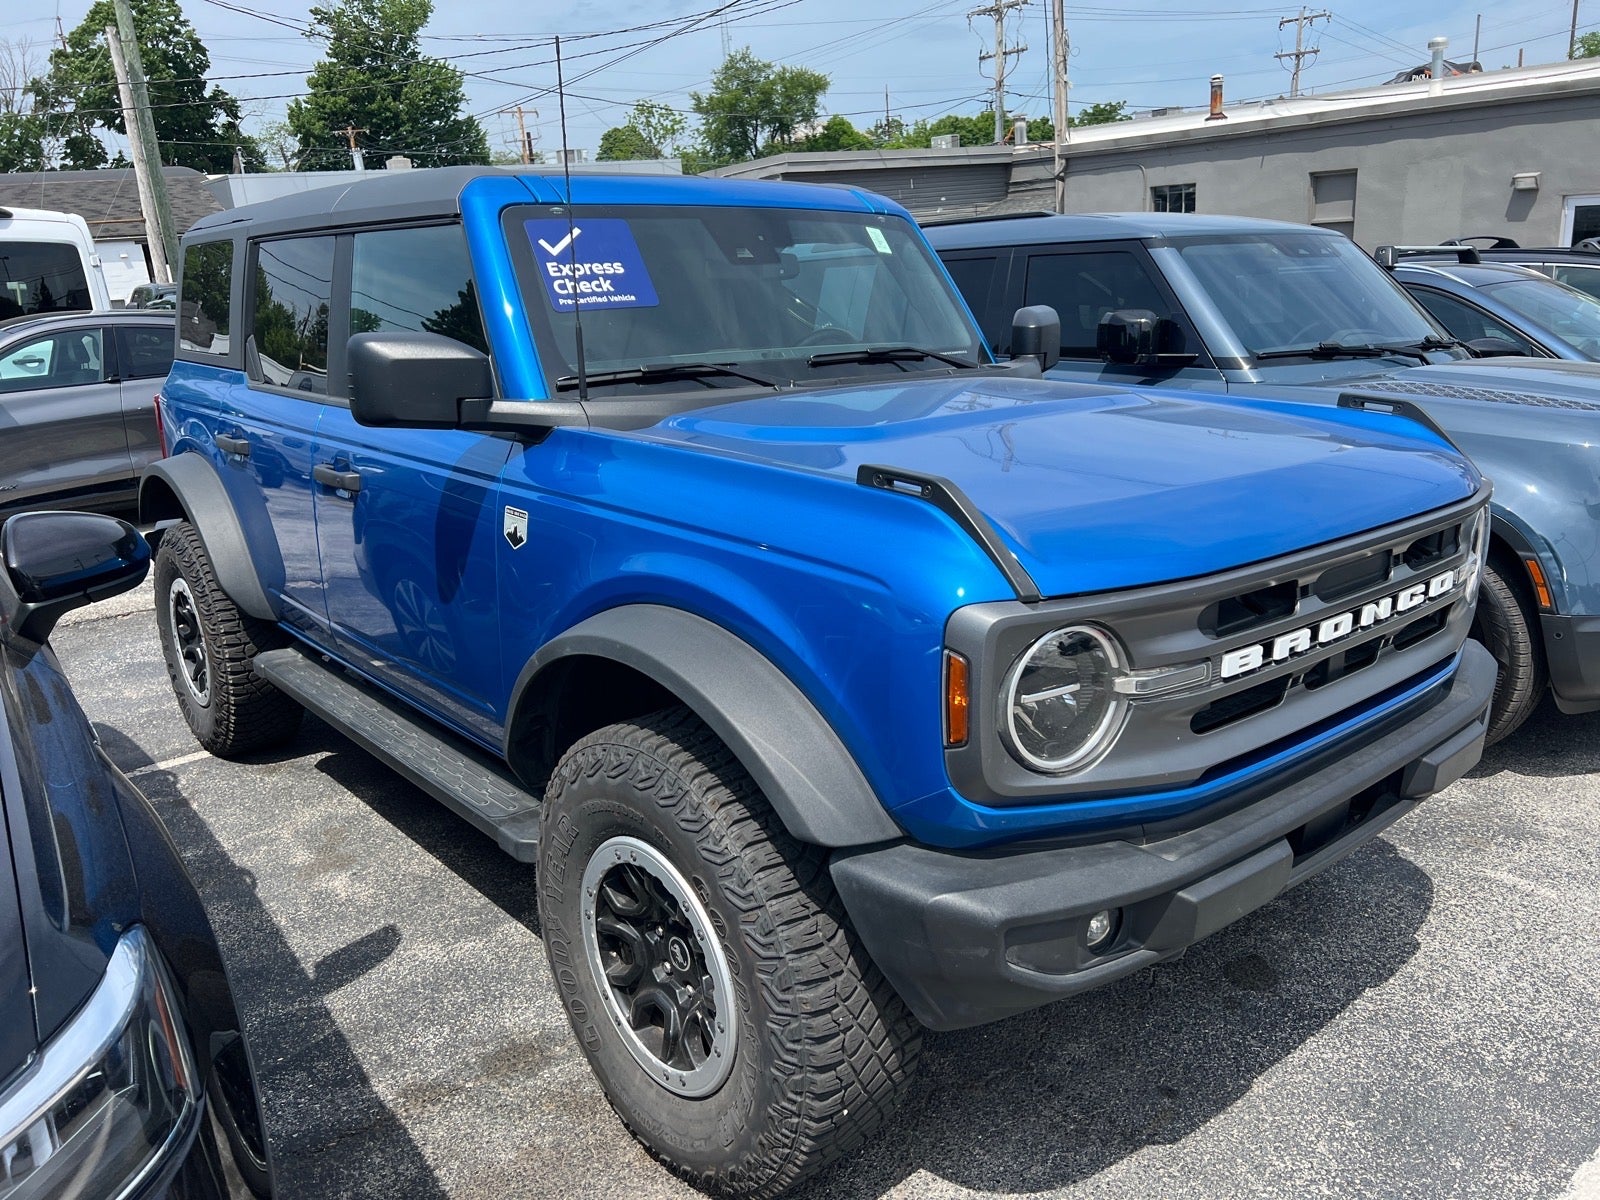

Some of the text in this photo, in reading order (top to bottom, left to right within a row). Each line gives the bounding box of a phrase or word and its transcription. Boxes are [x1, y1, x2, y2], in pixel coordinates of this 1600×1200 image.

[546, 262, 624, 278] Express
[553, 276, 615, 294] Check
[1220, 570, 1454, 678] BRONCO
